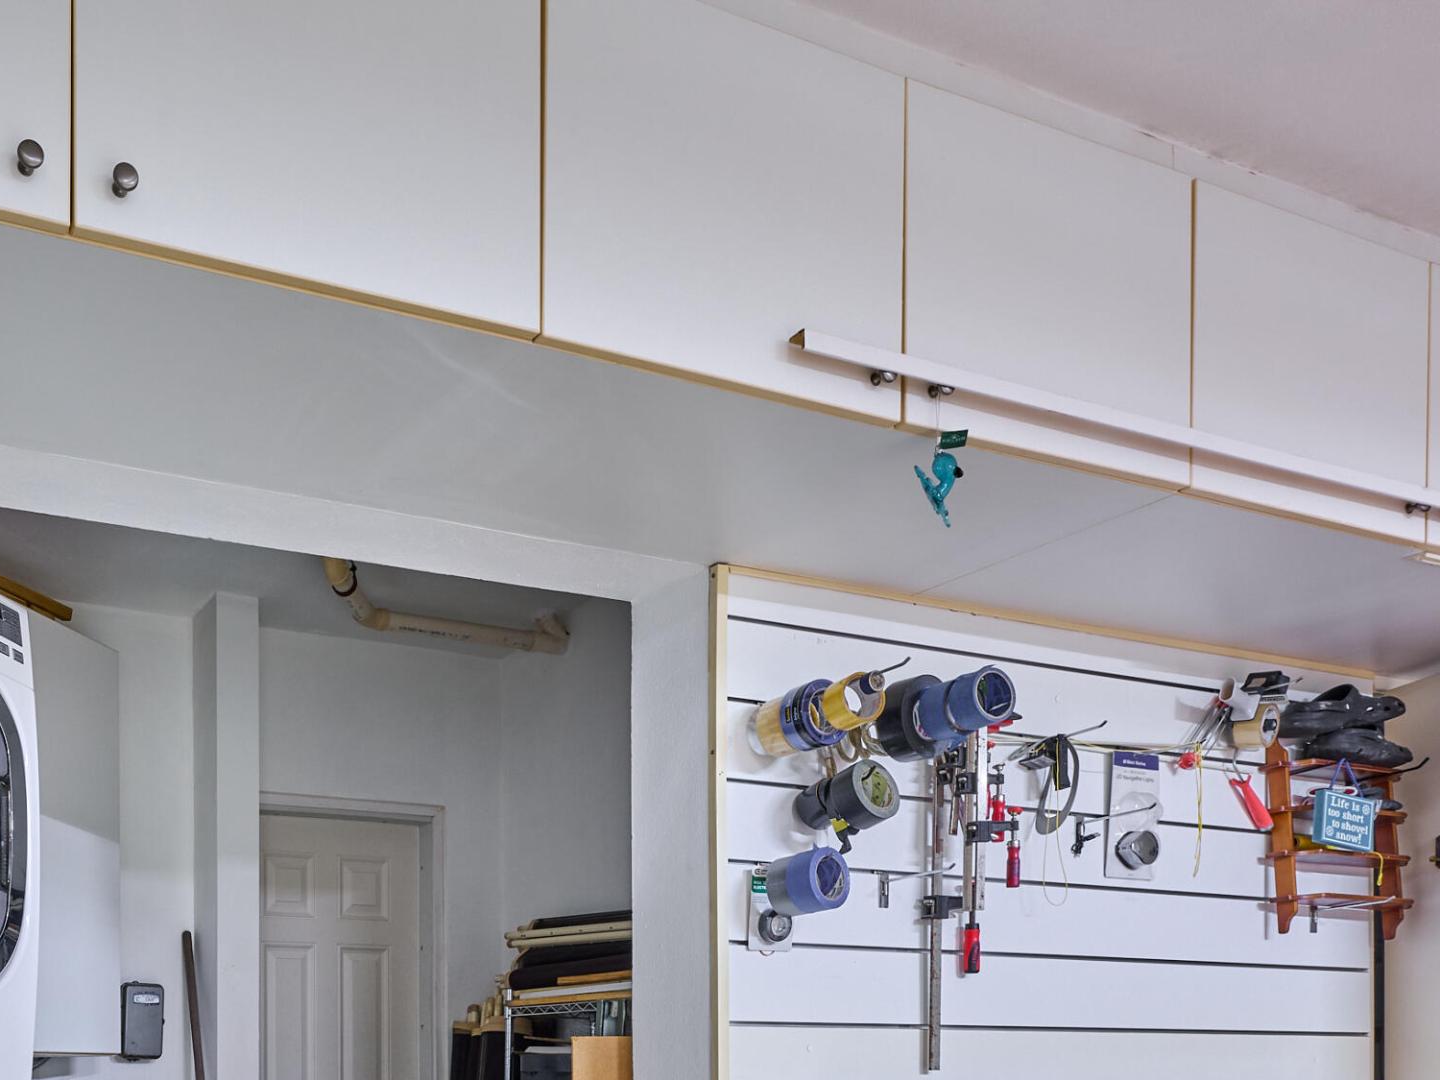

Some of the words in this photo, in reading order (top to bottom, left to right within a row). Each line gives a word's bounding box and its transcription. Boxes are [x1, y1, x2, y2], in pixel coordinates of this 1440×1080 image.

[1331, 796, 1350, 809] Life
[1352, 802, 1360, 811] is
[1328, 808, 1340, 817] too
[1342, 811, 1364, 823] short
[1332, 820, 1340, 828] to
[1341, 822, 1368, 835] shovel
[1335, 832, 1362, 844] snow!
